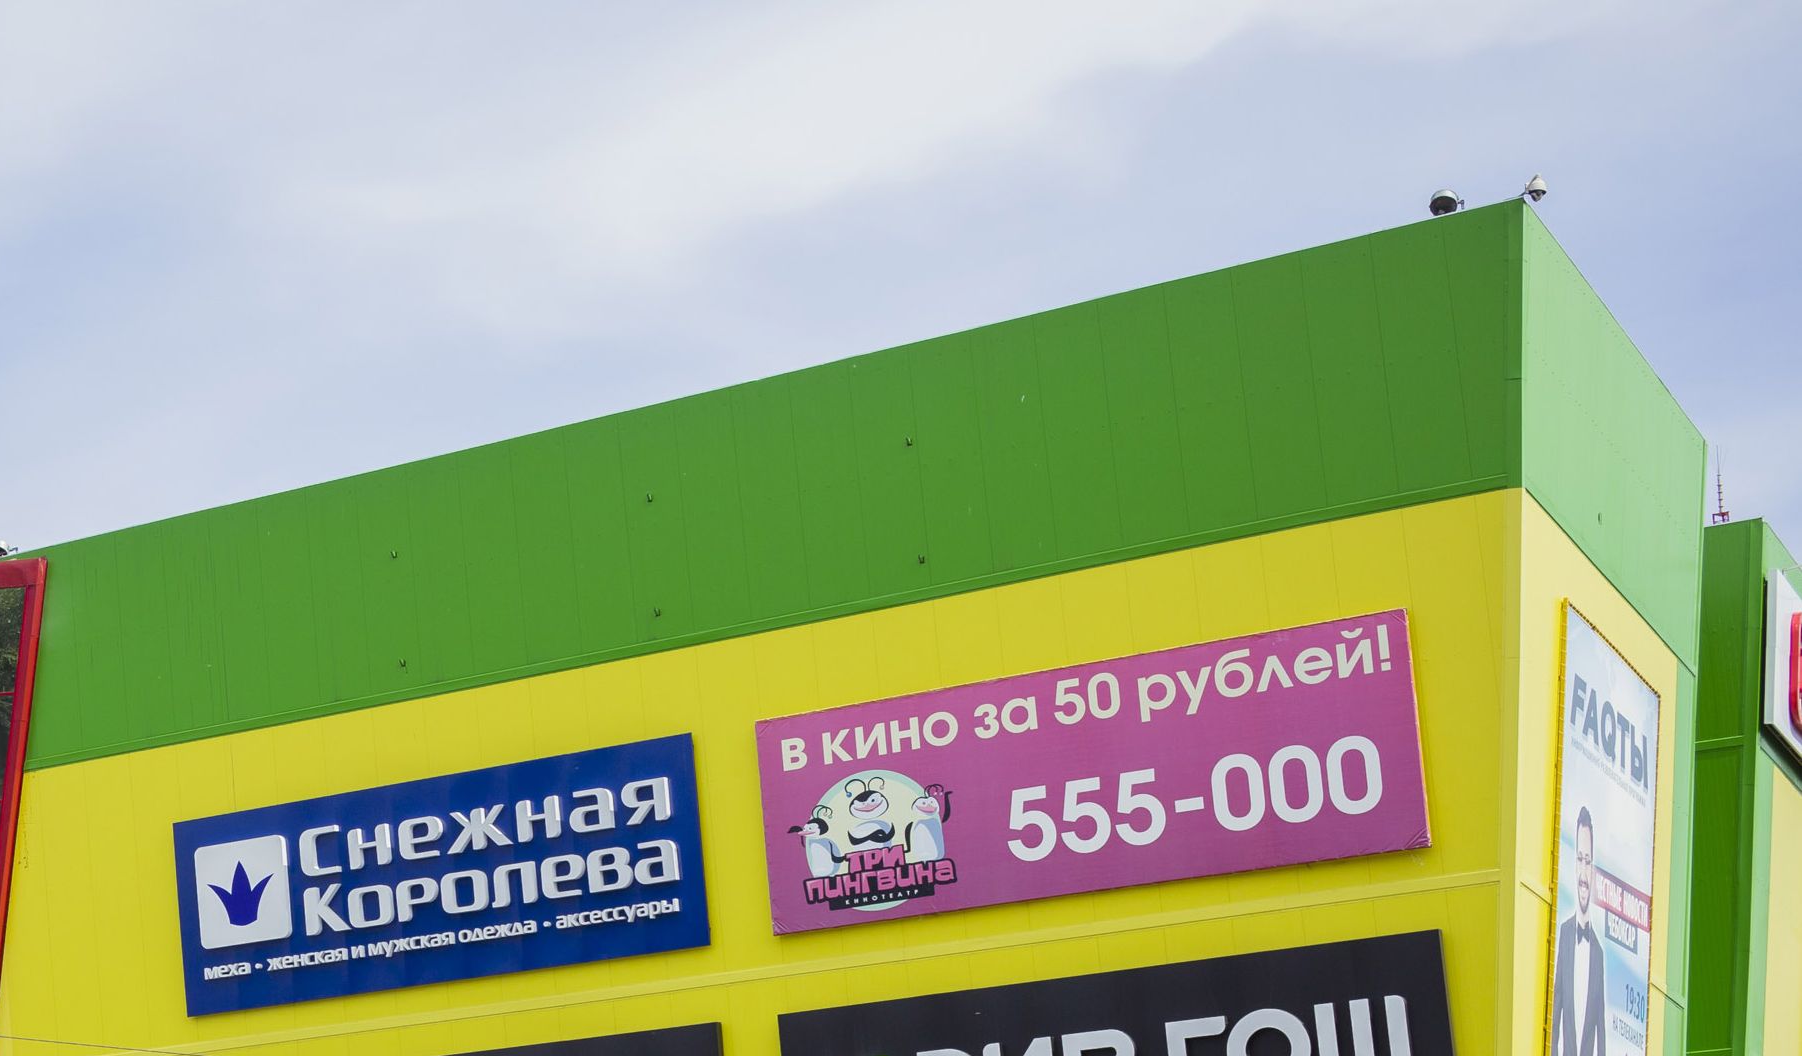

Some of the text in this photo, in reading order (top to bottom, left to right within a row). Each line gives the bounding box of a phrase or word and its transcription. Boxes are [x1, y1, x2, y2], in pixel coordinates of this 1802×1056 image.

[973, 695, 1038, 740] за
[1052, 672, 1121, 726] 50
[1137, 623, 1394, 722] рублей!
[298, 776, 672, 877] Снежная
[1006, 735, 1384, 863] 555-000
[303, 839, 682, 936] Королева
[845, 888, 920, 906] КИНОТЕАТР
[846, 846, 906, 873] ТРИ
[204, 898, 681, 981] меха женская и мужская одежда аксессуары
[1625, 984, 1646, 1024] 19:30
